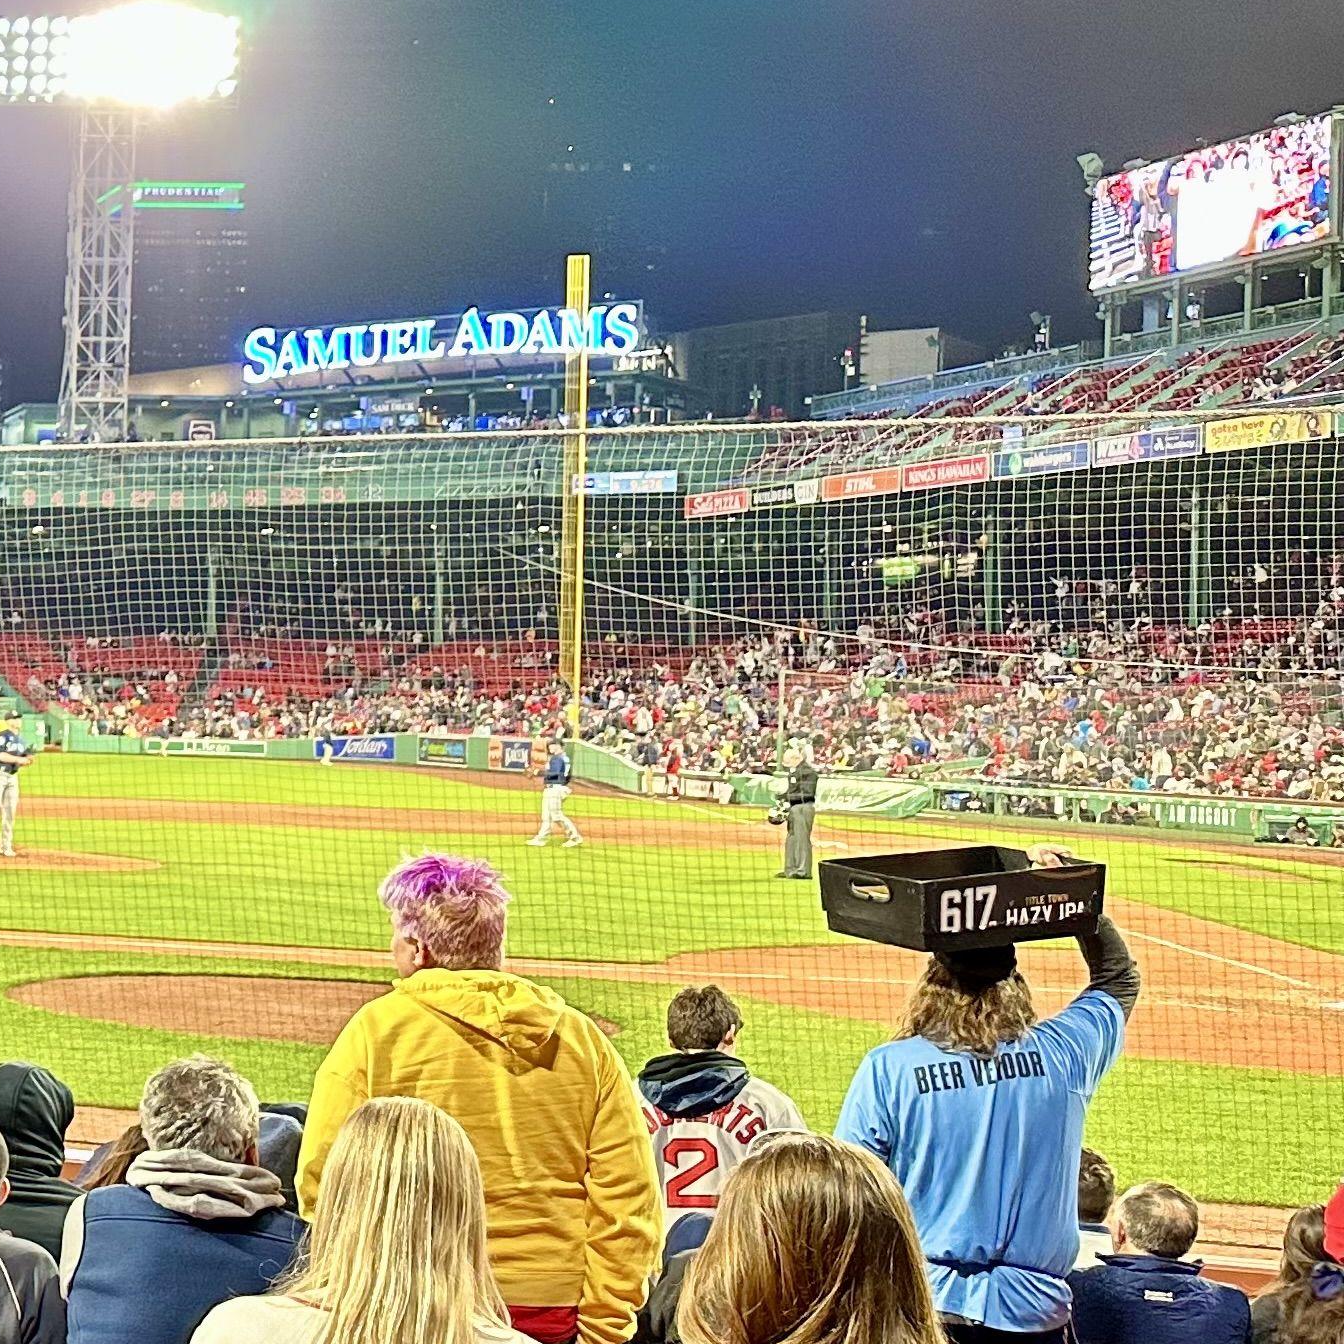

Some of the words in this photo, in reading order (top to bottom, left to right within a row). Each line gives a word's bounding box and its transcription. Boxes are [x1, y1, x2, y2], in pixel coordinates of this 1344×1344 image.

[243, 326, 445, 384] SAMUEL
[448, 306, 640, 358] ADAMS
[1190, 805, 1237, 827] DUGOUT
[940, 885, 997, 933] 617
[1005, 905, 1052, 927] HAZY
[1058, 900, 1085, 921] IPA
[1025, 894, 1045, 906] TITLE
[913, 1061, 966, 1094] BEER
[662, 1137, 723, 1209] 2
